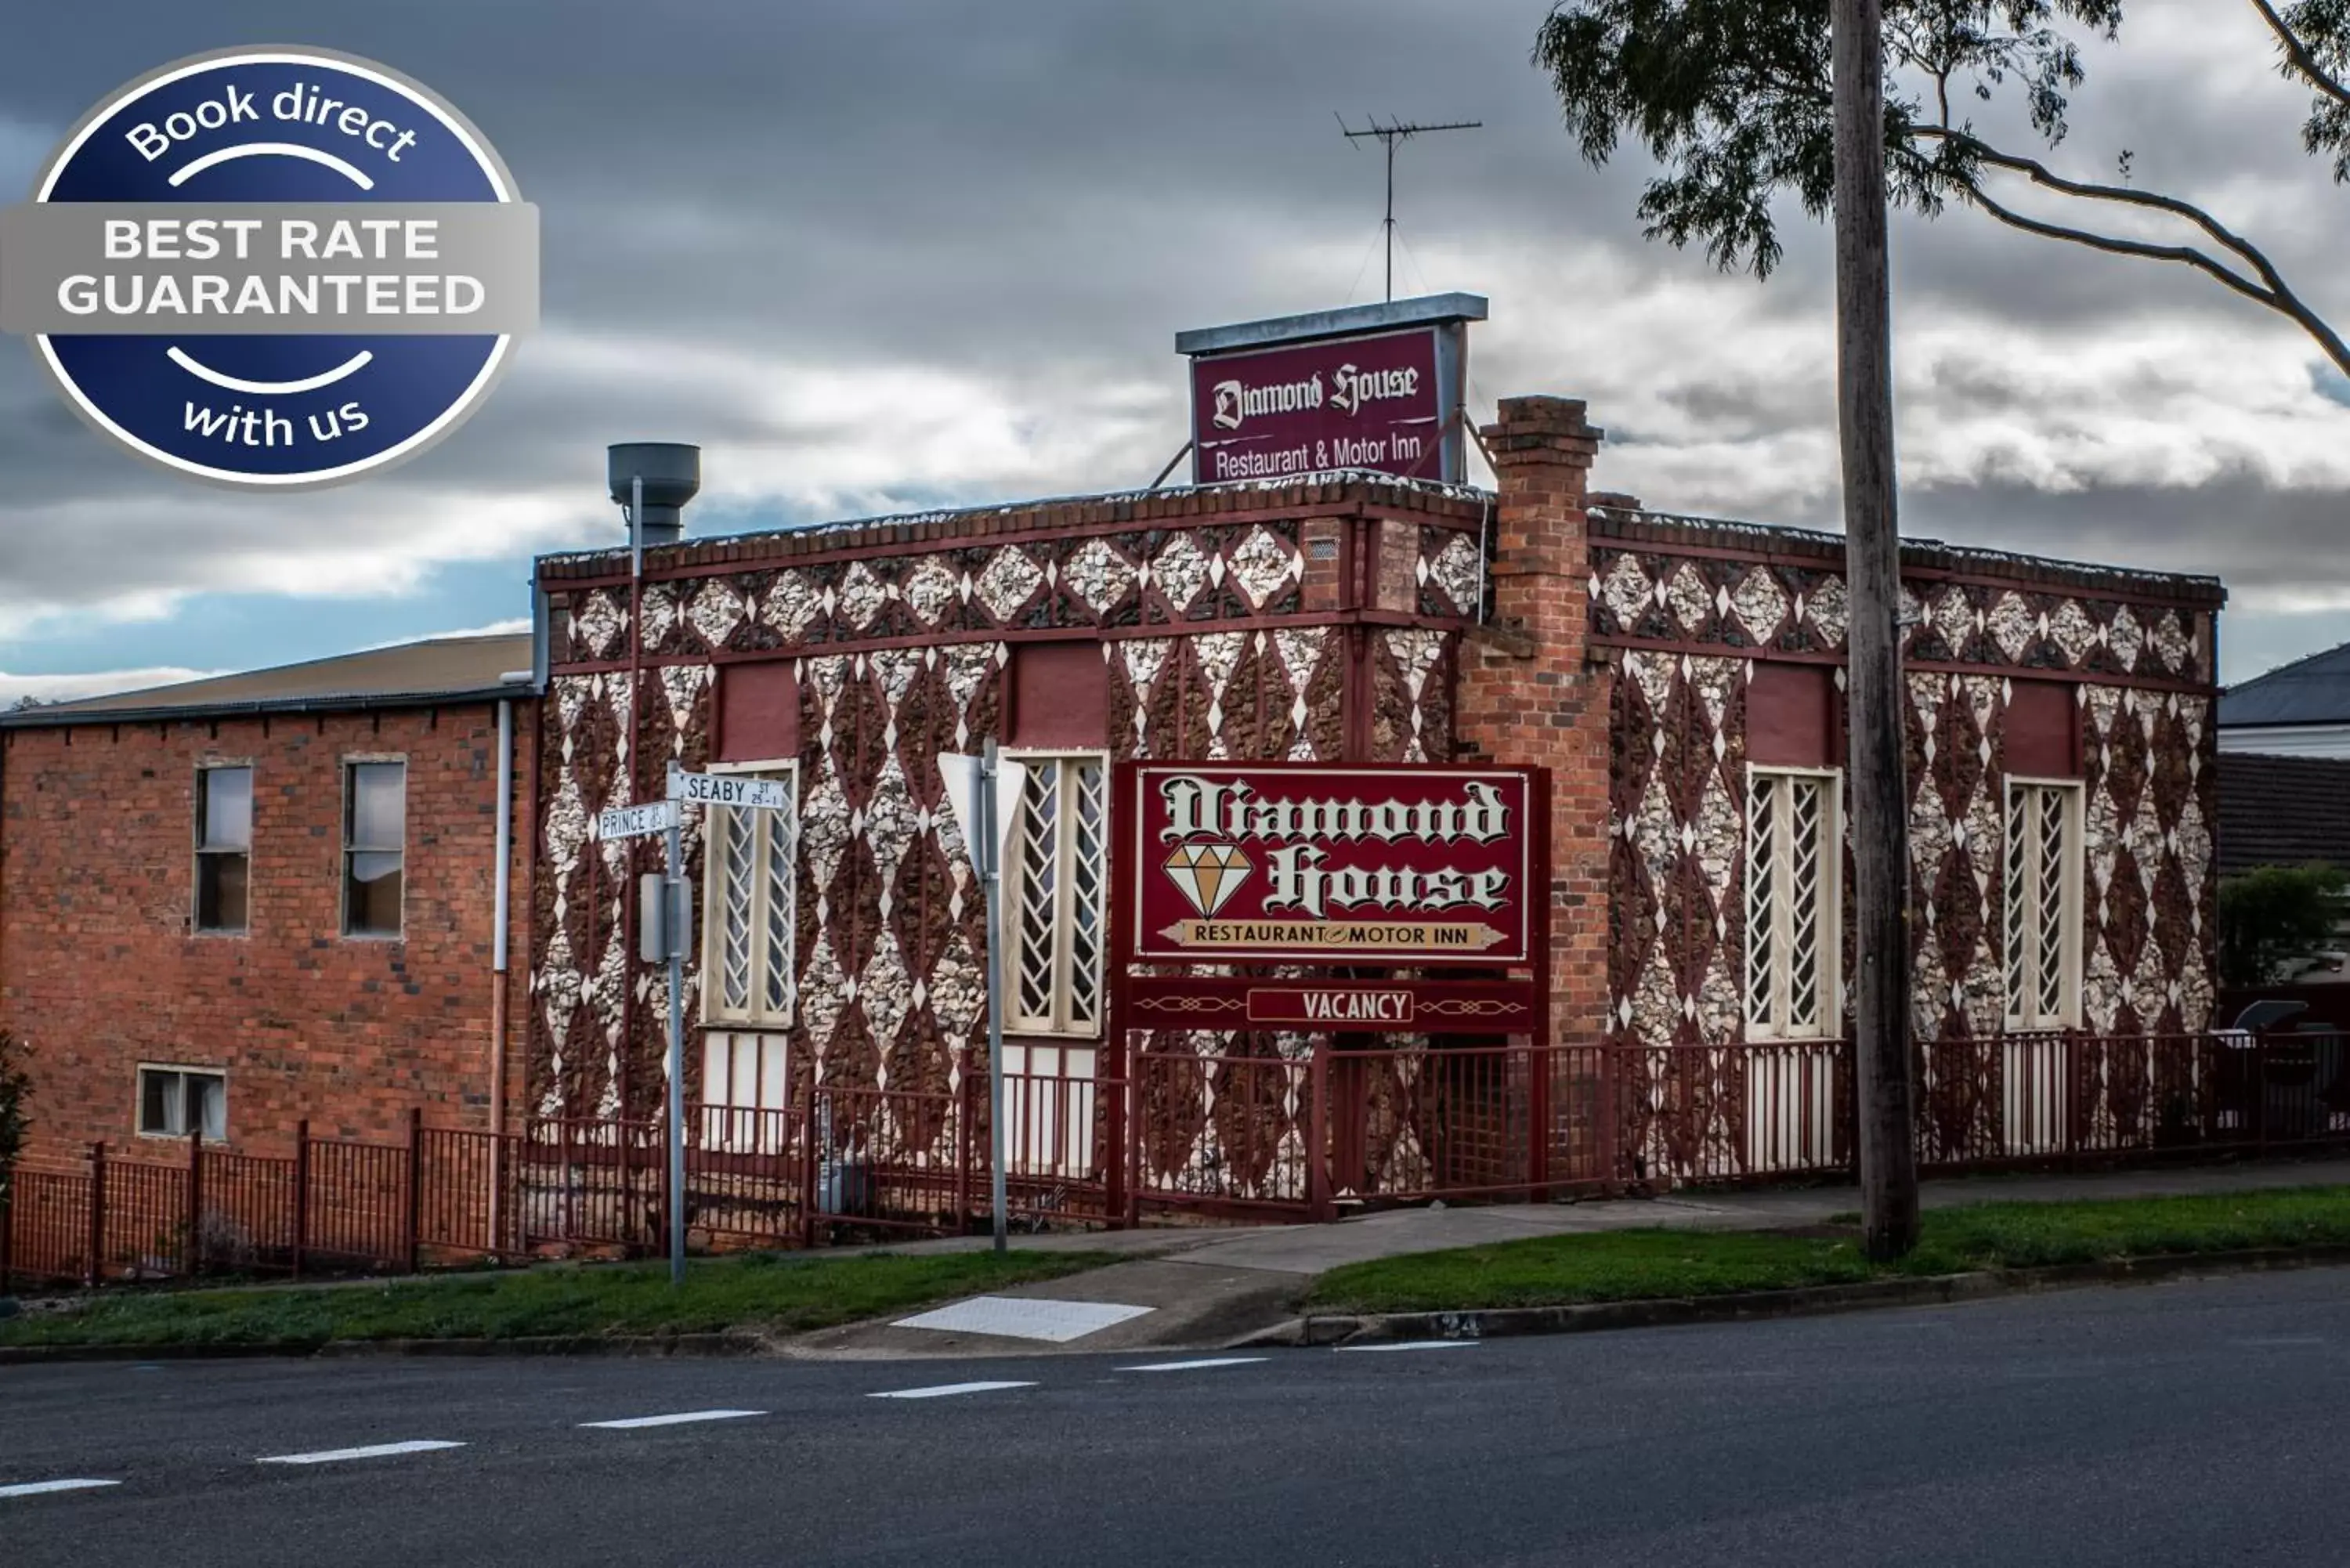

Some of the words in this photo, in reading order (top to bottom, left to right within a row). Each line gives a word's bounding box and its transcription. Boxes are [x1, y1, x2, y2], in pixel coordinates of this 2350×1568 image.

[1212, 370, 1324, 430] Diamond
[1329, 363, 1419, 417] House
[1216, 447, 1309, 479] Restaurant
[1315, 439, 1329, 469] &
[1334, 436, 1386, 465] Motor
[1391, 432, 1421, 461] Inn
[689, 778, 744, 803] SEABY
[602, 808, 645, 836] PRINCE
[1159, 775, 1512, 847] Diamond
[1261, 843, 1512, 919] House
[1195, 926, 1325, 941] RESTAURANT
[1349, 927, 1424, 943] MOTOR
[1434, 928, 1468, 944] INN
[1303, 992, 1408, 1020] VACANCY
